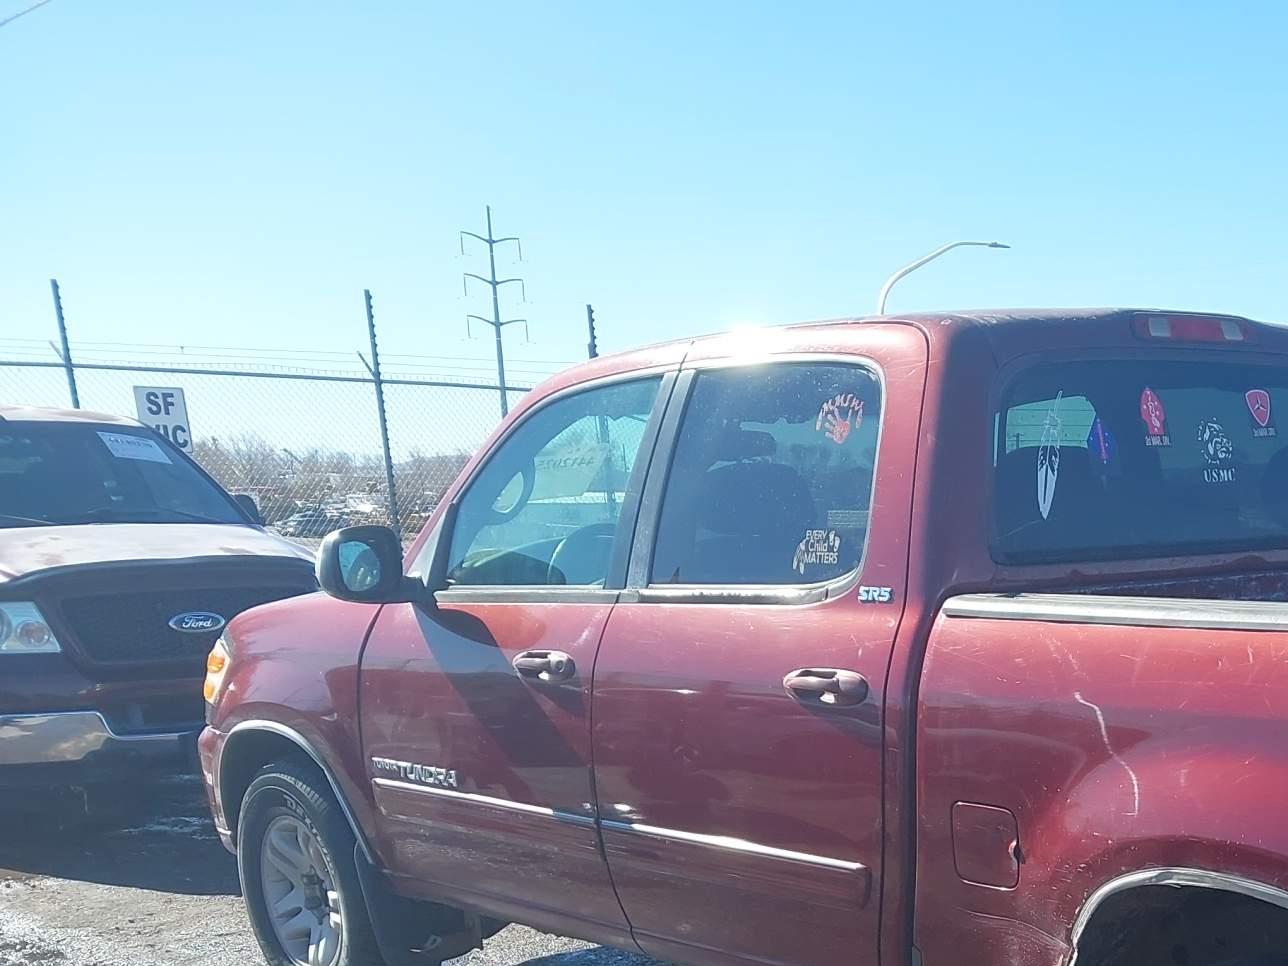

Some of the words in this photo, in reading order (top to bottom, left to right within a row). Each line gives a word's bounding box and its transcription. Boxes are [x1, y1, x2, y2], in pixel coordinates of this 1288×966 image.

[145, 391, 175, 416] SF
[154, 424, 189, 448] IC
[1204, 468, 1236, 482] USMC
[805, 529, 828, 540] EVERY
[808, 540, 828, 551] Child
[803, 551, 838, 564] MATTERS
[858, 586, 892, 602] SR5
[399, 763, 458, 788] TUNDRA
